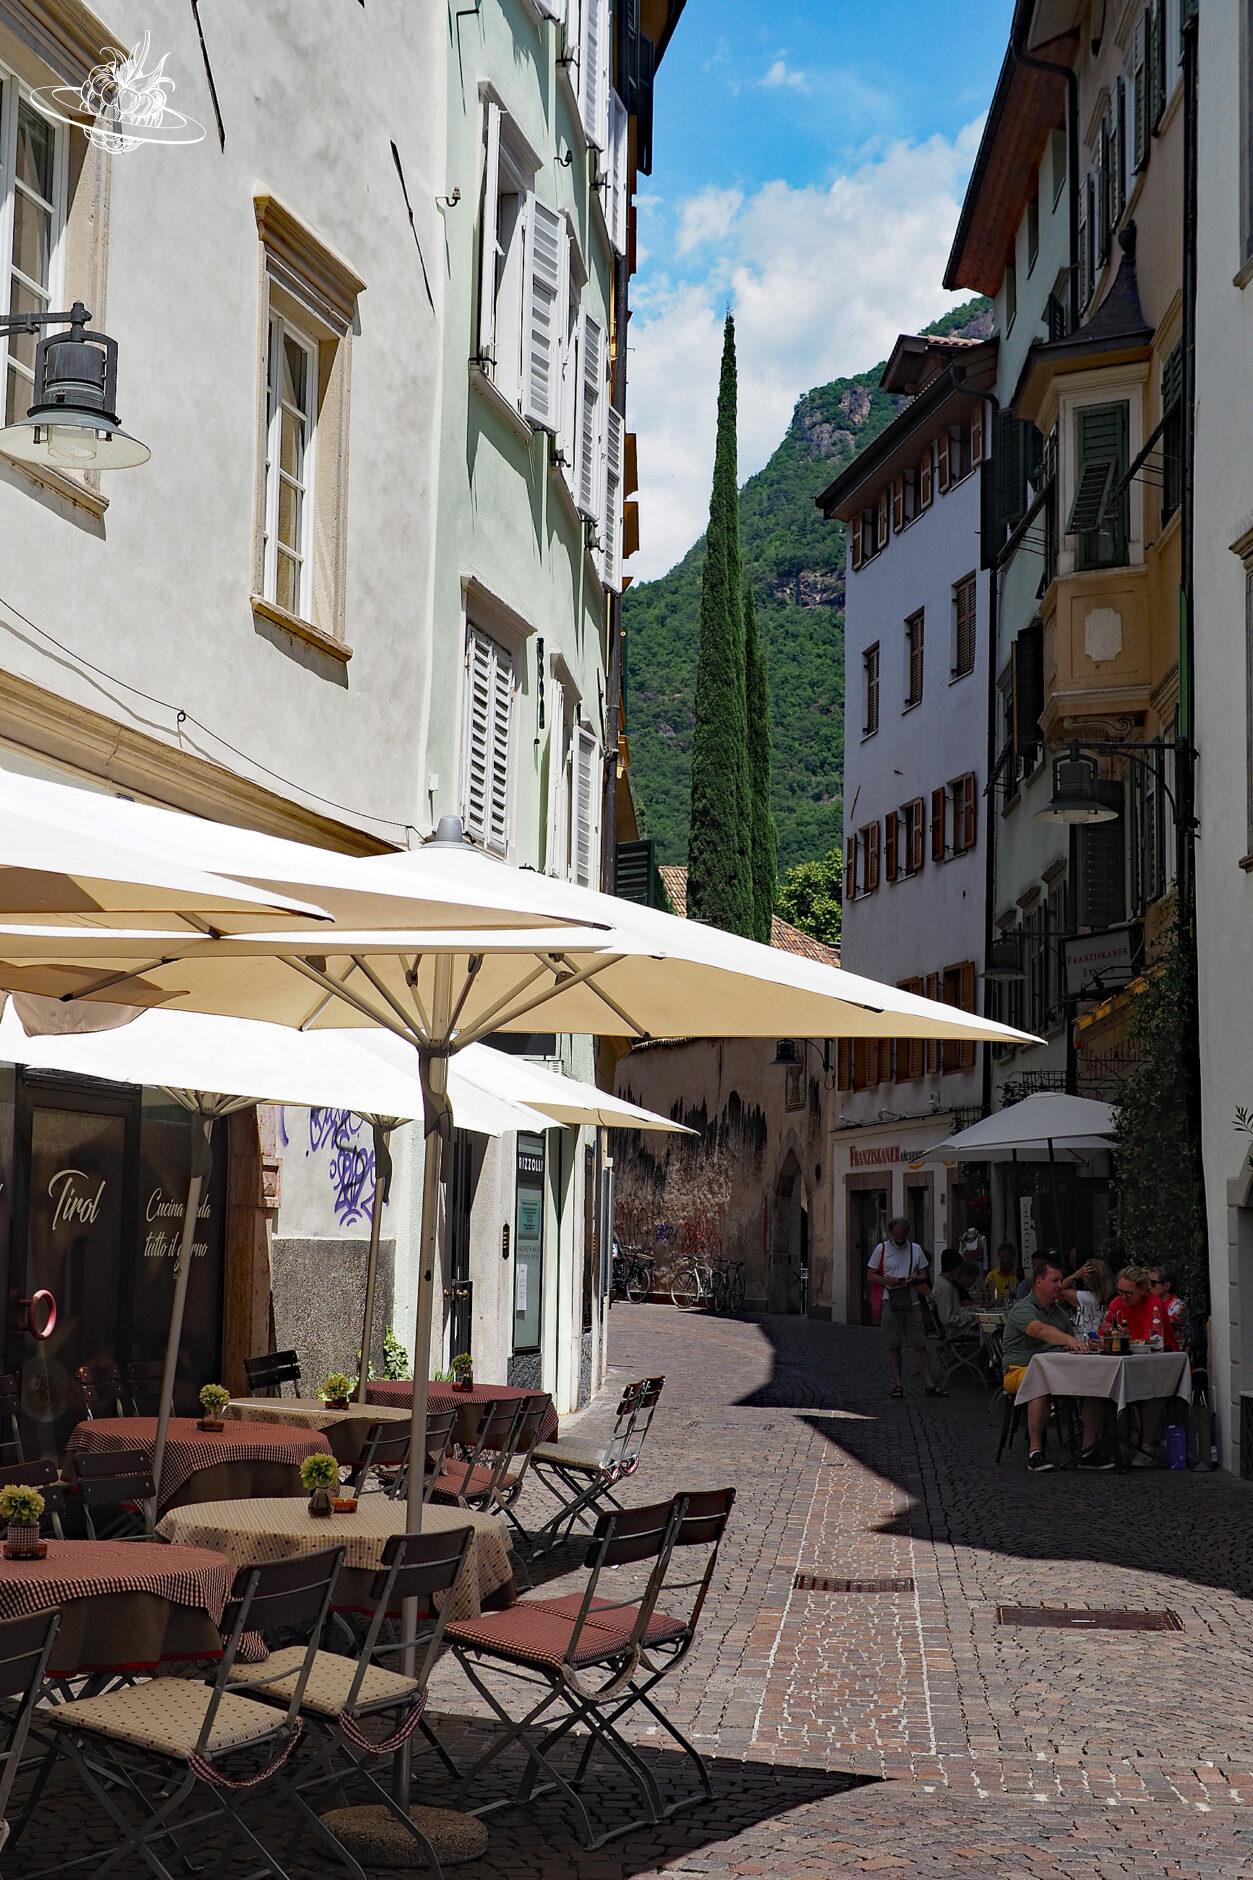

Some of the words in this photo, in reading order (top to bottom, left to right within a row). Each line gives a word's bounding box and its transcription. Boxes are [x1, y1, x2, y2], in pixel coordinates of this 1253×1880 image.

[1067, 947, 1128, 965] FRANZISKANER
[849, 1145, 900, 1167] FRANZISKANER
[48, 1169, 106, 1231] Tirol
[145, 1187, 185, 1222] Cucina
[144, 1231, 168, 1257] tutto
[168, 1231, 180, 1257] il
